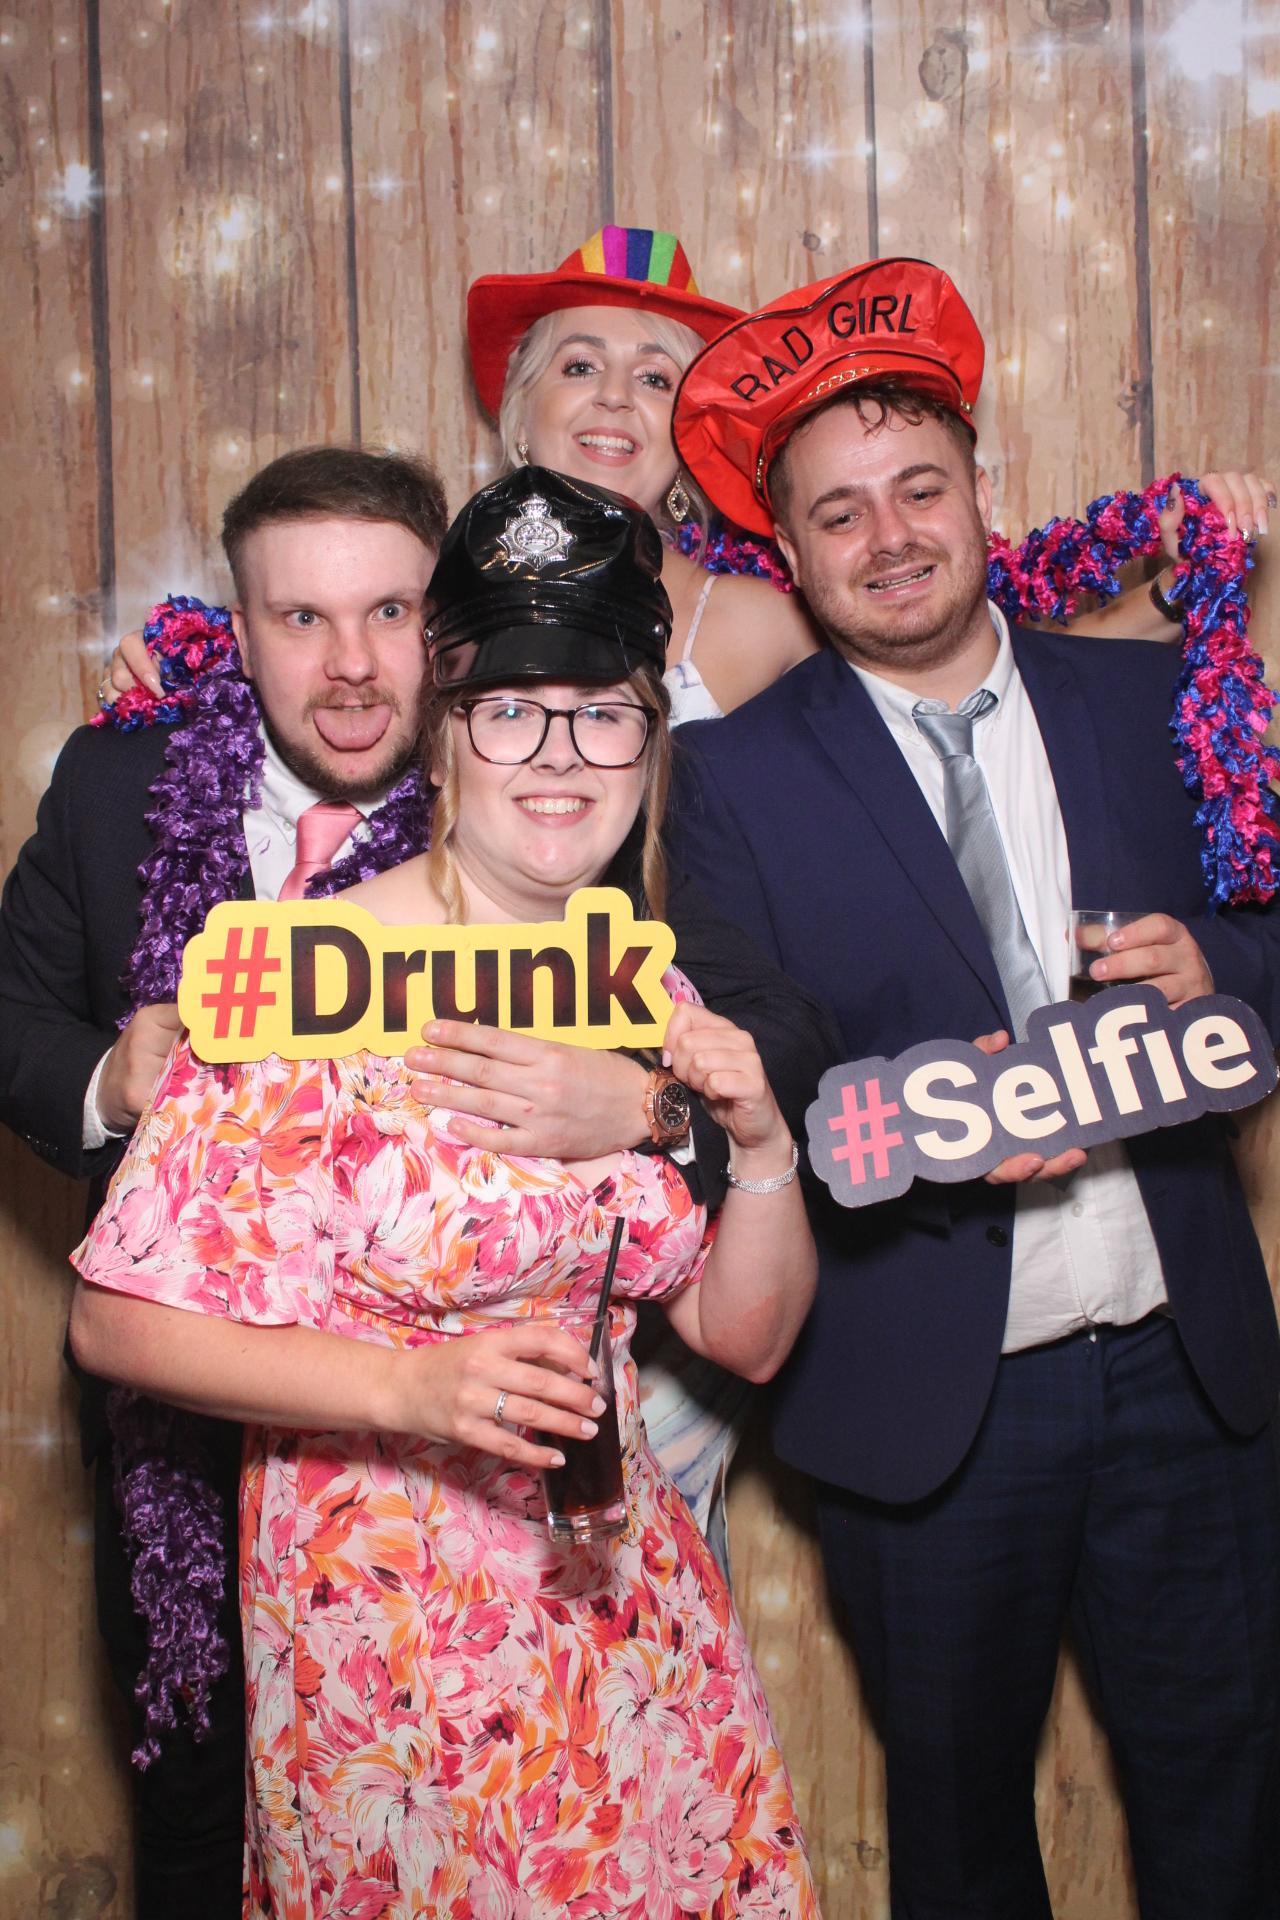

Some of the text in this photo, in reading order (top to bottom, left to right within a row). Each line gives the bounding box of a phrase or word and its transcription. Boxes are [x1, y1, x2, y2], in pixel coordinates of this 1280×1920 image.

[827, 294, 917, 339] GIRL
[201, 912, 657, 1039] #Drunk
[827, 1004, 1258, 1185] #Selfie
